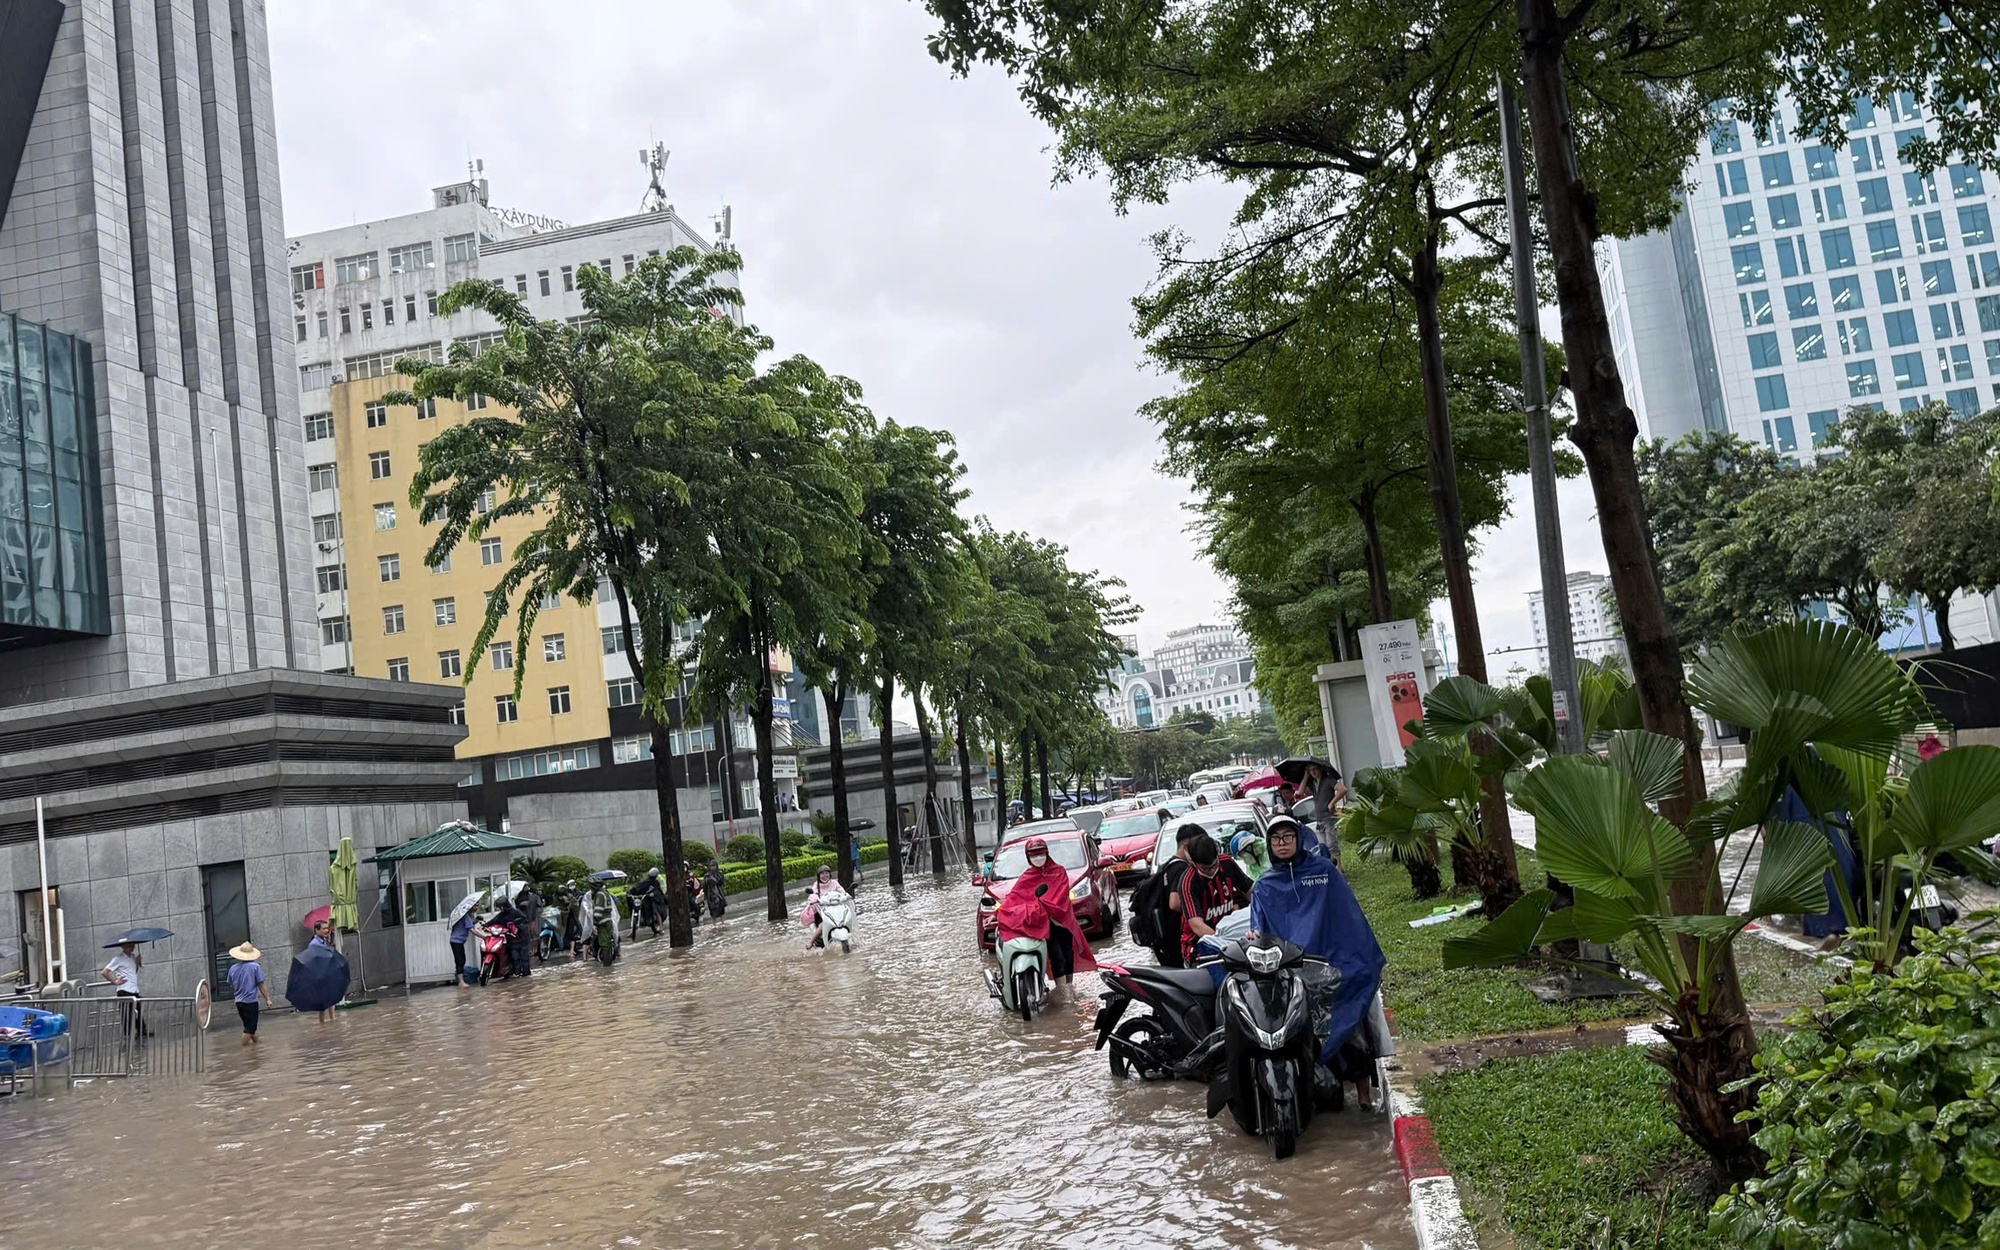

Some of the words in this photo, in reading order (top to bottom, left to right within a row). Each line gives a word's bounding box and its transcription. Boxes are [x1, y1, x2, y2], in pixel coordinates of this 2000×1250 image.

[1378, 640, 1402, 651] 27.490
[1386, 671, 1416, 683] PRO
[1206, 899, 1234, 921] bwin
